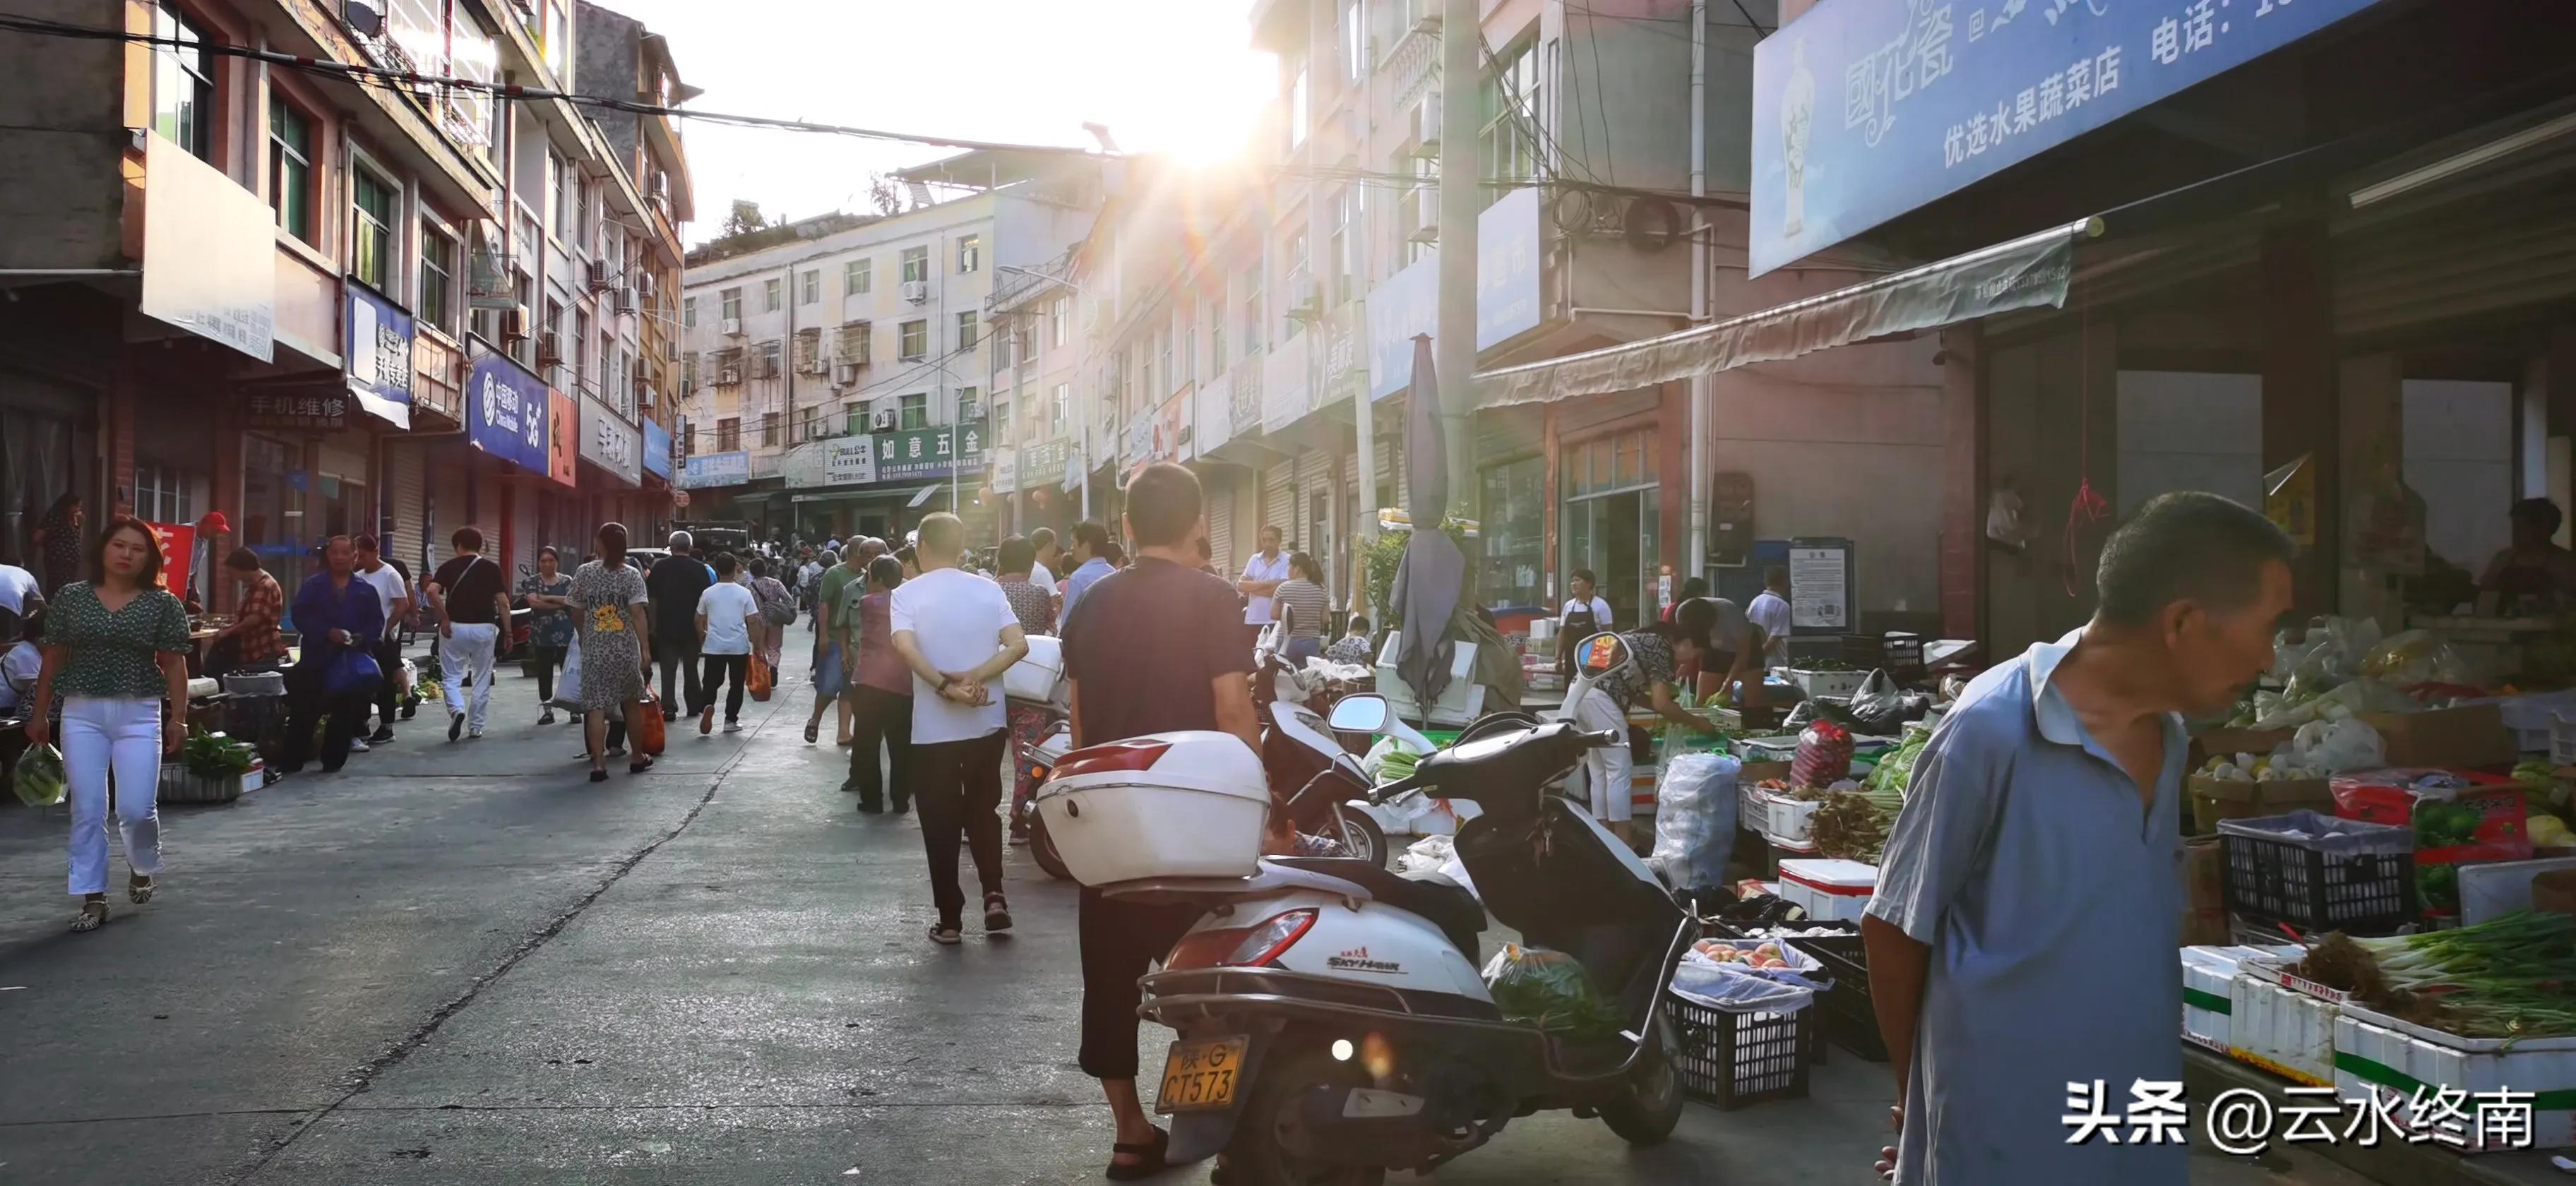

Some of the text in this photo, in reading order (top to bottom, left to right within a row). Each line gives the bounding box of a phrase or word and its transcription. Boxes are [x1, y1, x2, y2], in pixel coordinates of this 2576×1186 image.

[1944, 45, 2122, 169] 优选水果蔬菜店
[249, 395, 345, 417] 手机维修
[496, 381, 519, 414] 中国移动
[882, 430, 979, 460] 如意五金
[1164, 1070, 1233, 1103] CT573
